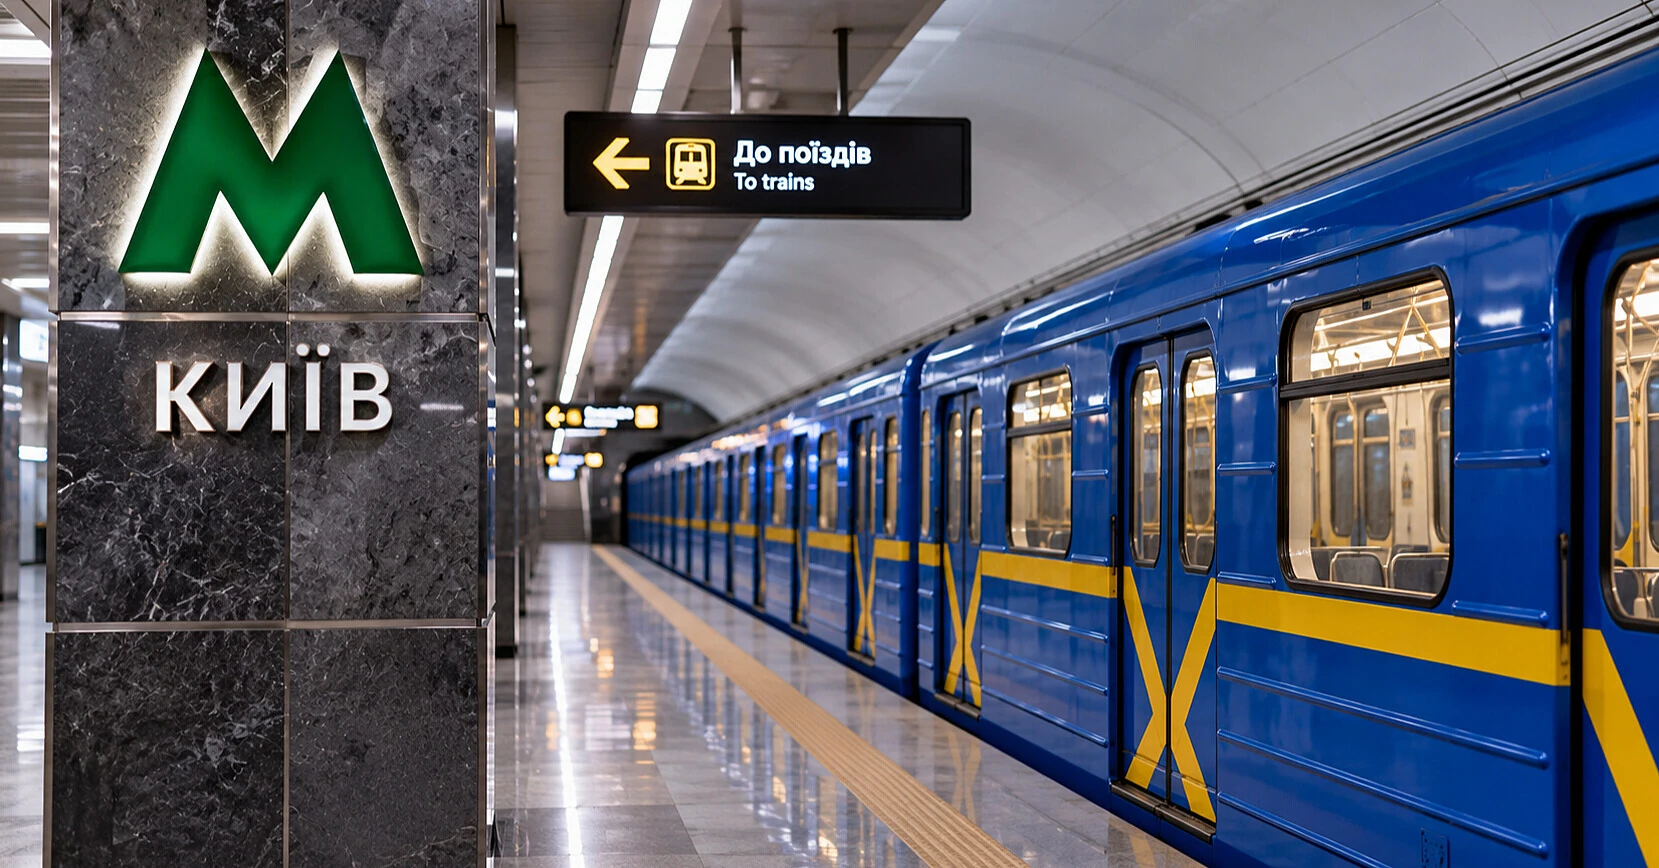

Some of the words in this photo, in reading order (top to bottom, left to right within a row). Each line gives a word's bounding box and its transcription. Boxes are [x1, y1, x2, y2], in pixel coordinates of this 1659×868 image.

[733, 139, 772, 167] До
[778, 140, 872, 168] поїздів
[733, 172, 758, 191] To
[761, 172, 815, 191] trains
[155, 343, 393, 432] КИЇВ
